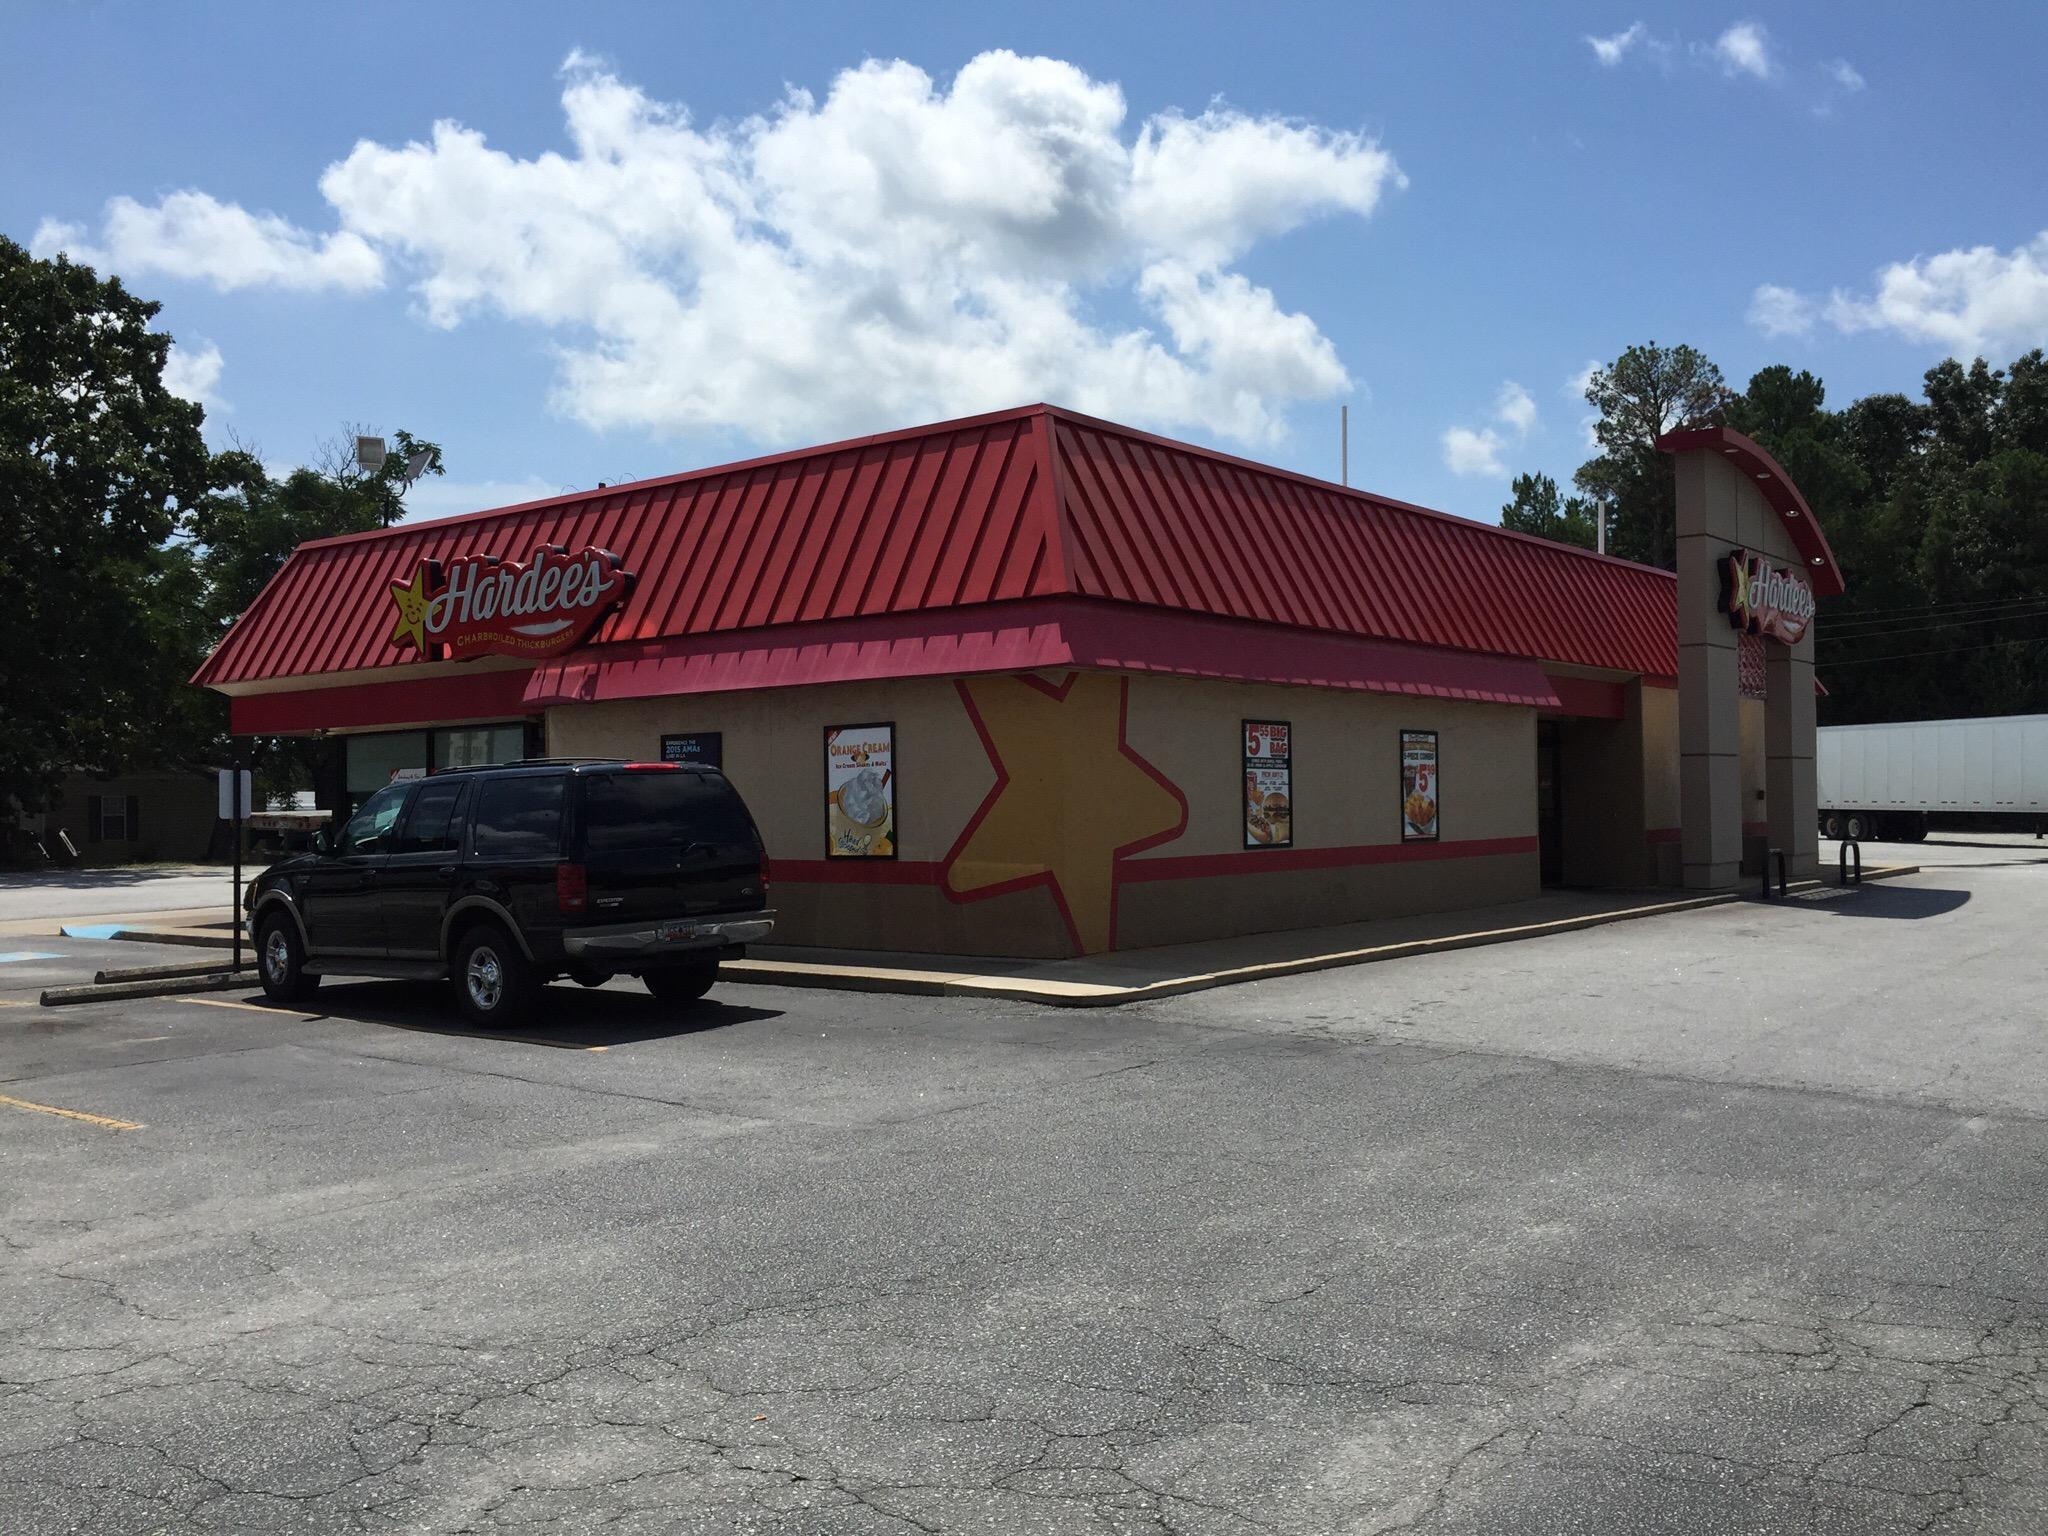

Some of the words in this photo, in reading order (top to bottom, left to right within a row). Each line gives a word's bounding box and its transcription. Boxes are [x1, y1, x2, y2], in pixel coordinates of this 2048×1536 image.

[425, 552, 614, 633] Hardee's
[456, 632, 516, 646] CHARBROILED
[1270, 726, 1287, 738] BIG
[665, 745, 681, 753] 2015
[831, 744, 861, 756] ORANGE
[862, 742, 890, 754] CREAM
[1270, 741, 1288, 754] BAG
[1418, 764, 1428, 792] 5
